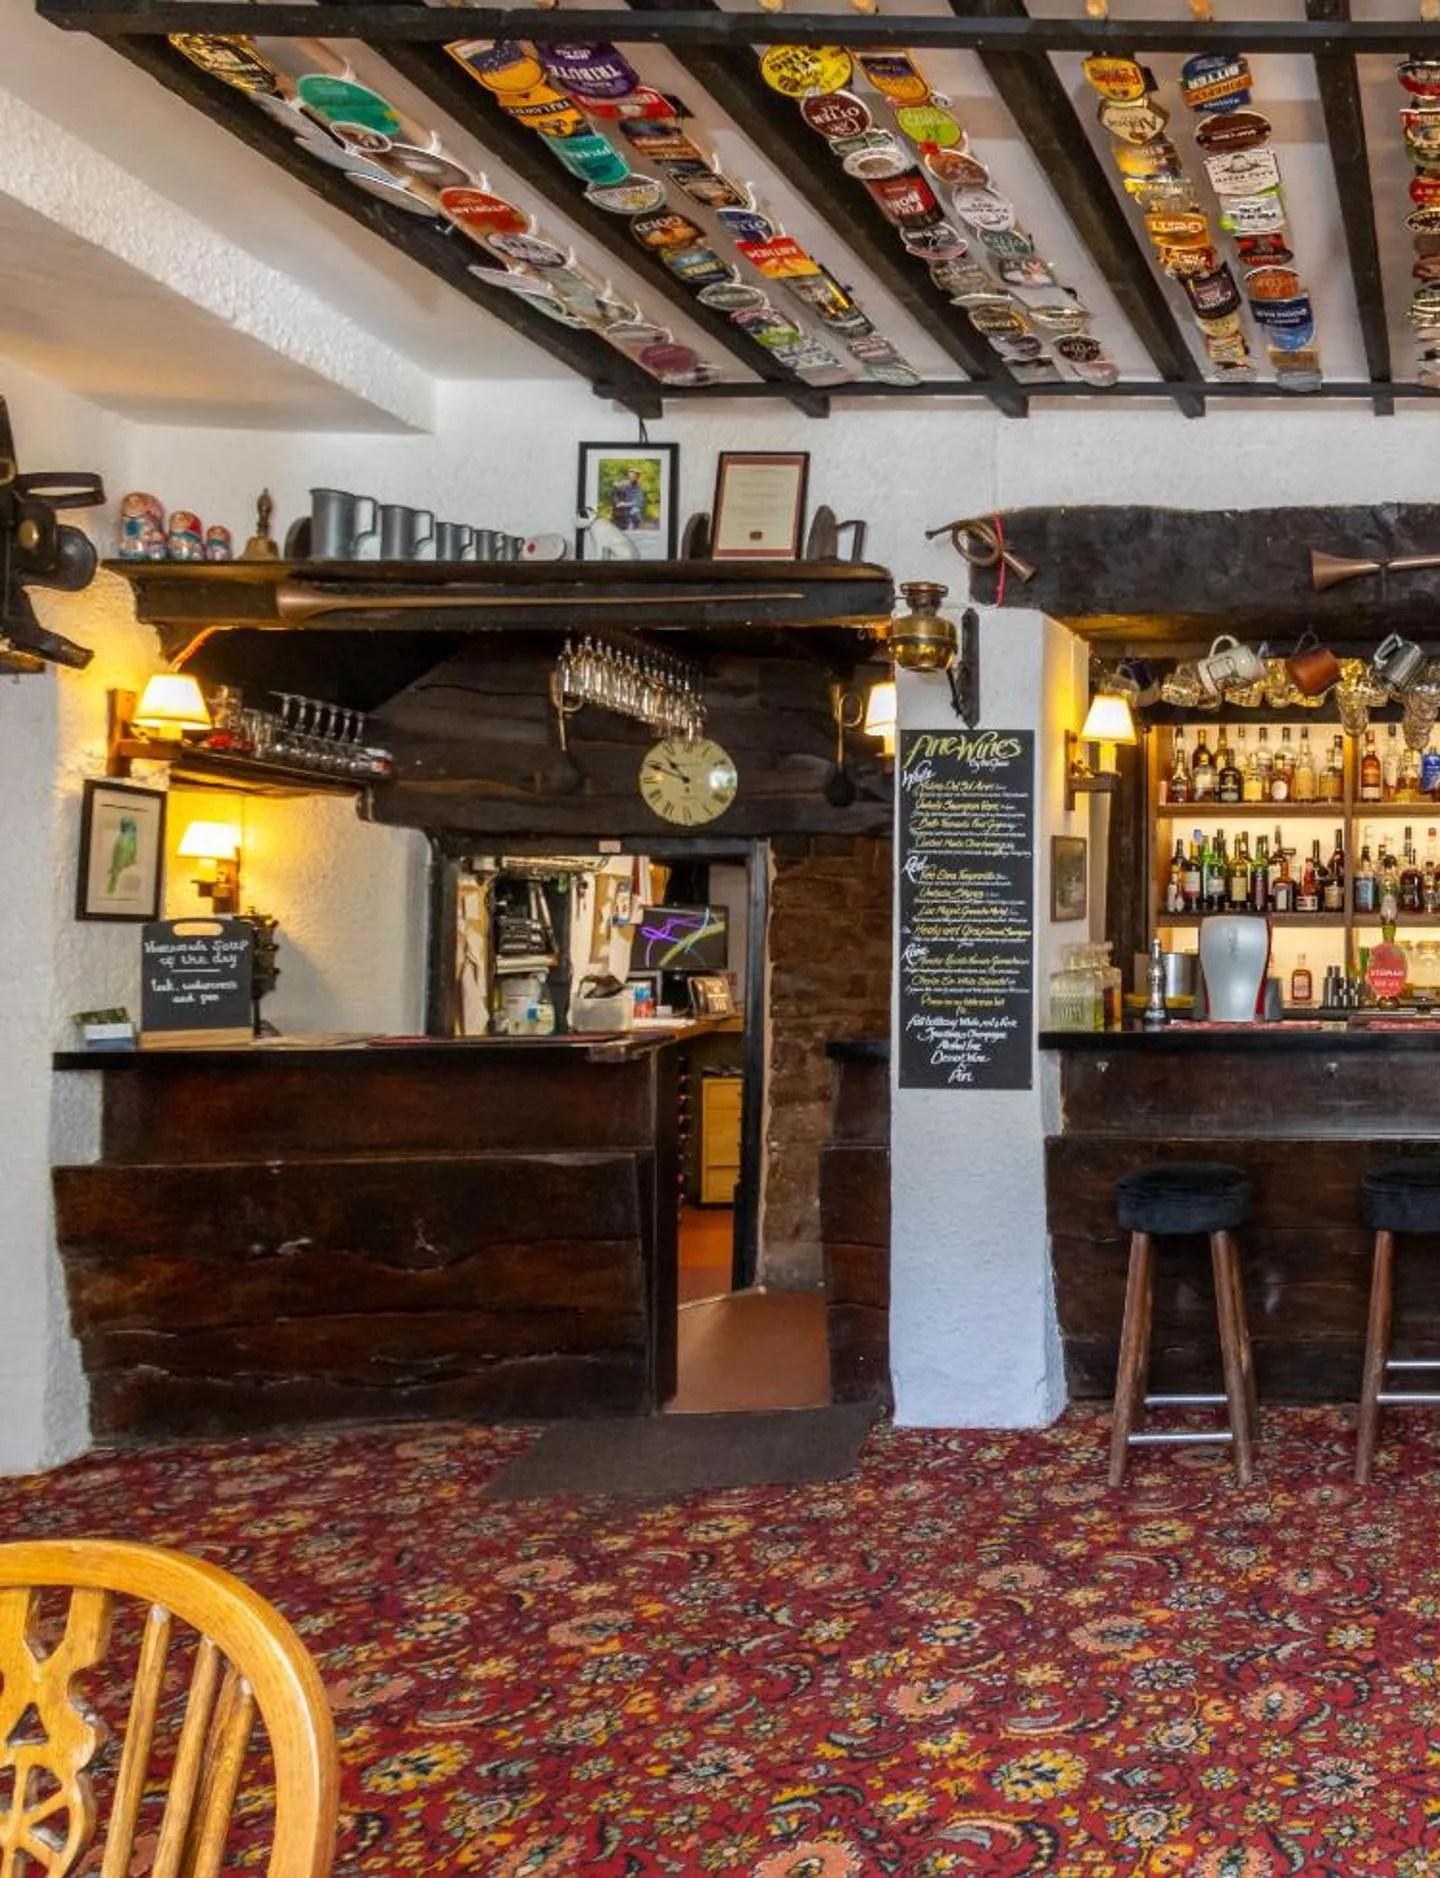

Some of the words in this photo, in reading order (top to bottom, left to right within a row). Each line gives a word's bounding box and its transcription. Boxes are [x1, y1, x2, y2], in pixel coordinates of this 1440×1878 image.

[545, 64, 621, 81] TRIBUTE
[1187, 63, 1239, 90] BITTER
[810, 107, 861, 125] OTTER
[213, 952, 238, 969] day
[172, 993, 195, 1003] and
